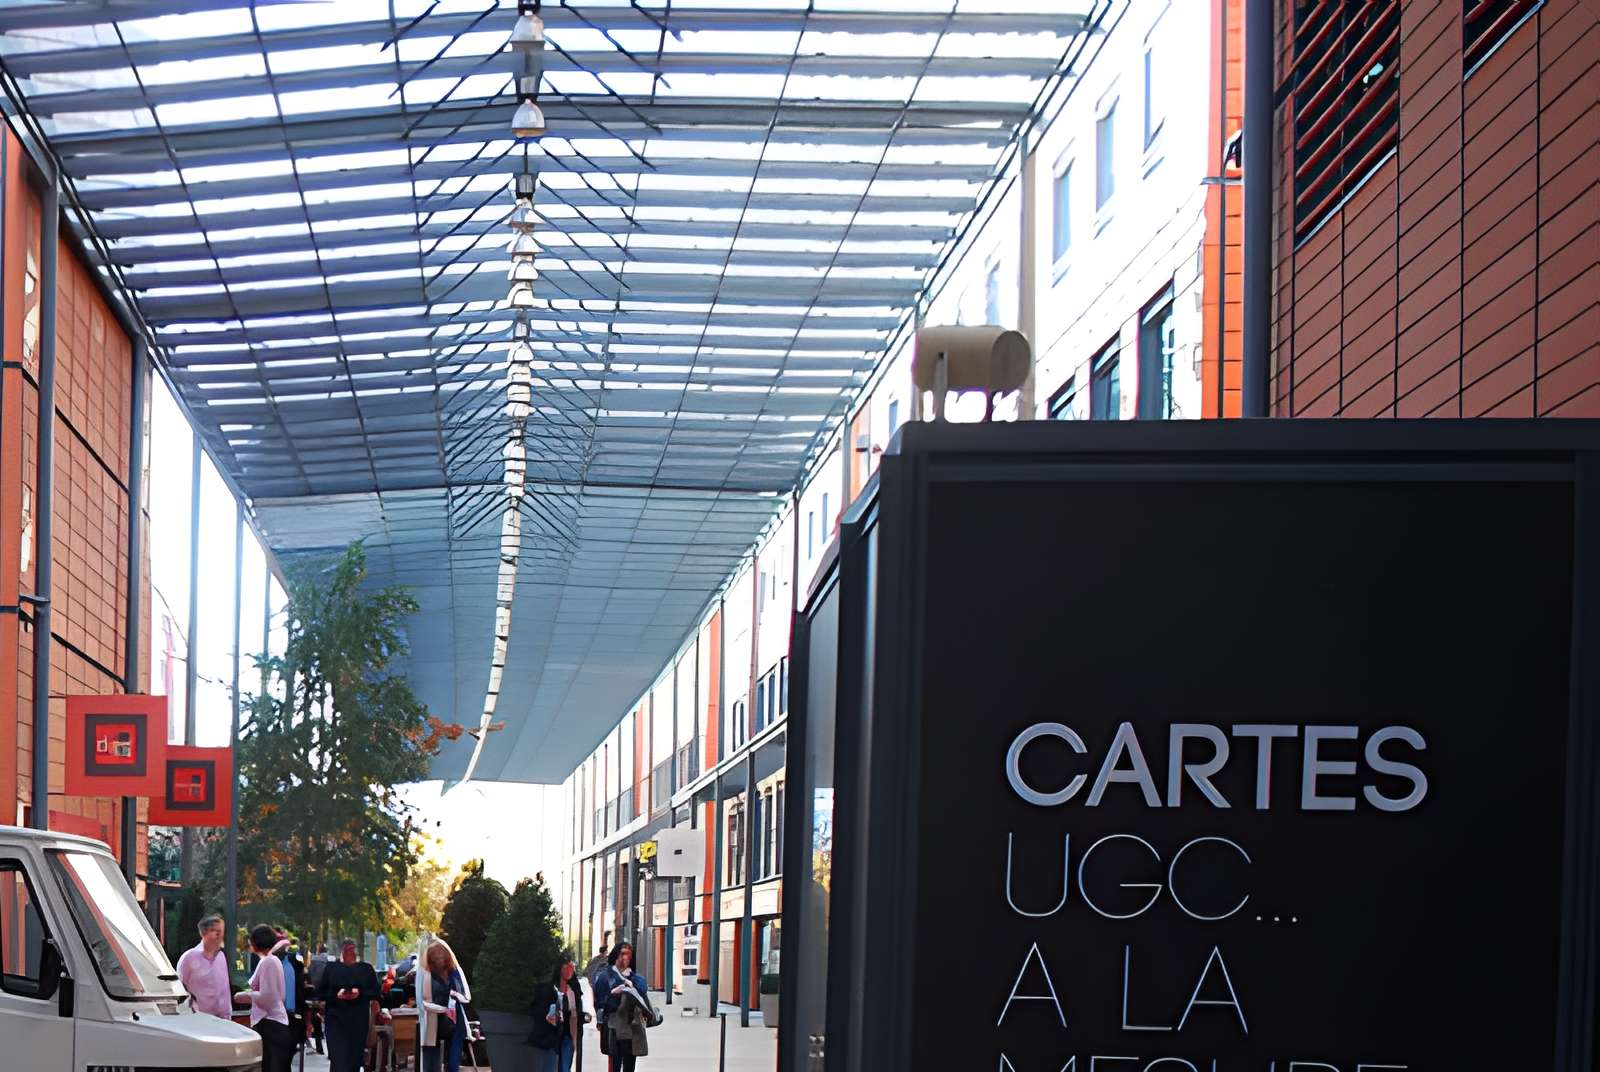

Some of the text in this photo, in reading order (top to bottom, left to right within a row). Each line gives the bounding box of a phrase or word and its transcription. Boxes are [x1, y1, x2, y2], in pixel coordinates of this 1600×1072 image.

[1005, 721, 1428, 812] CARTES
[1006, 831, 1299, 923] UGC...
[997, 942, 1248, 1033] A LA
